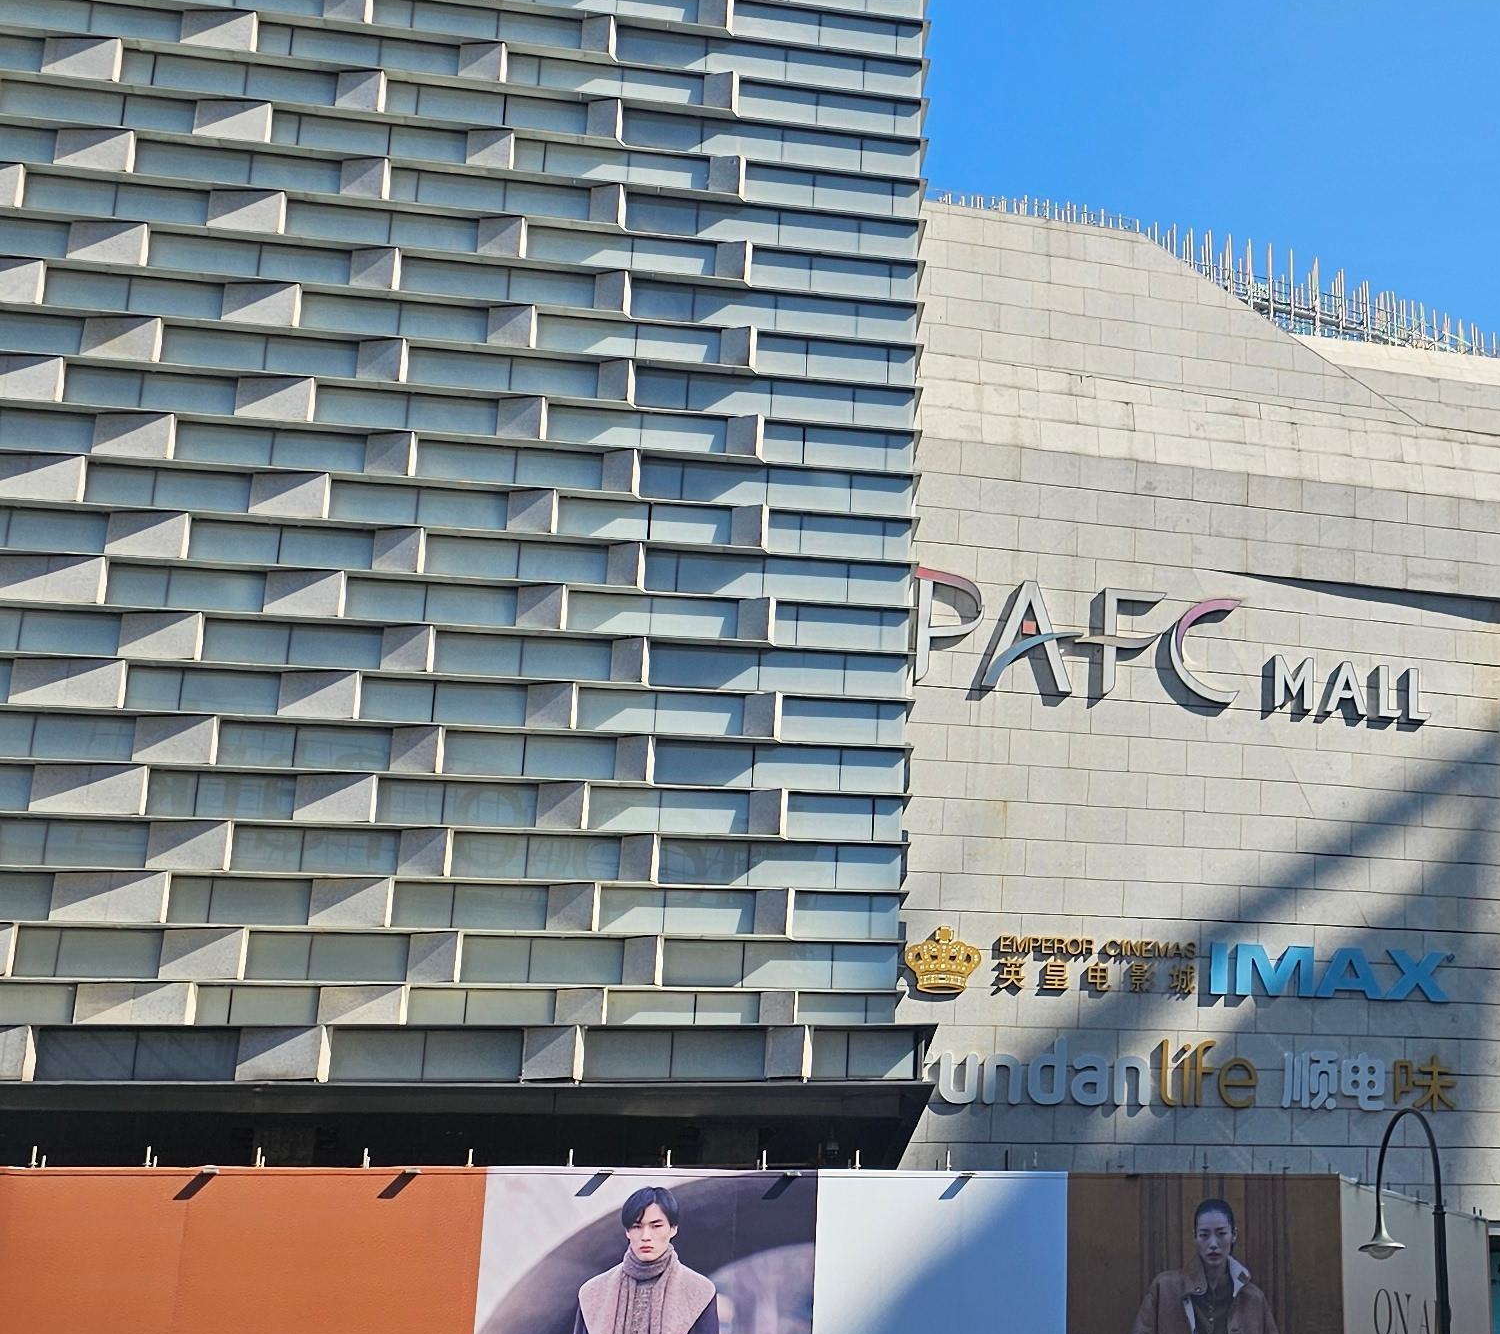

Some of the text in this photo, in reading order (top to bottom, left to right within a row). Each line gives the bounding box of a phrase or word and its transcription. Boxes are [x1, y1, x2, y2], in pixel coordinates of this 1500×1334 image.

[914, 567, 1431, 722] PAFC MALL
[998, 958, 1196, 993] 英皇电影城
[999, 935, 1196, 959] EMPEROR CINEMAS
[1208, 942, 1450, 1004] IMAX
[934, 1038, 1457, 1113] undanlife 顺电味
